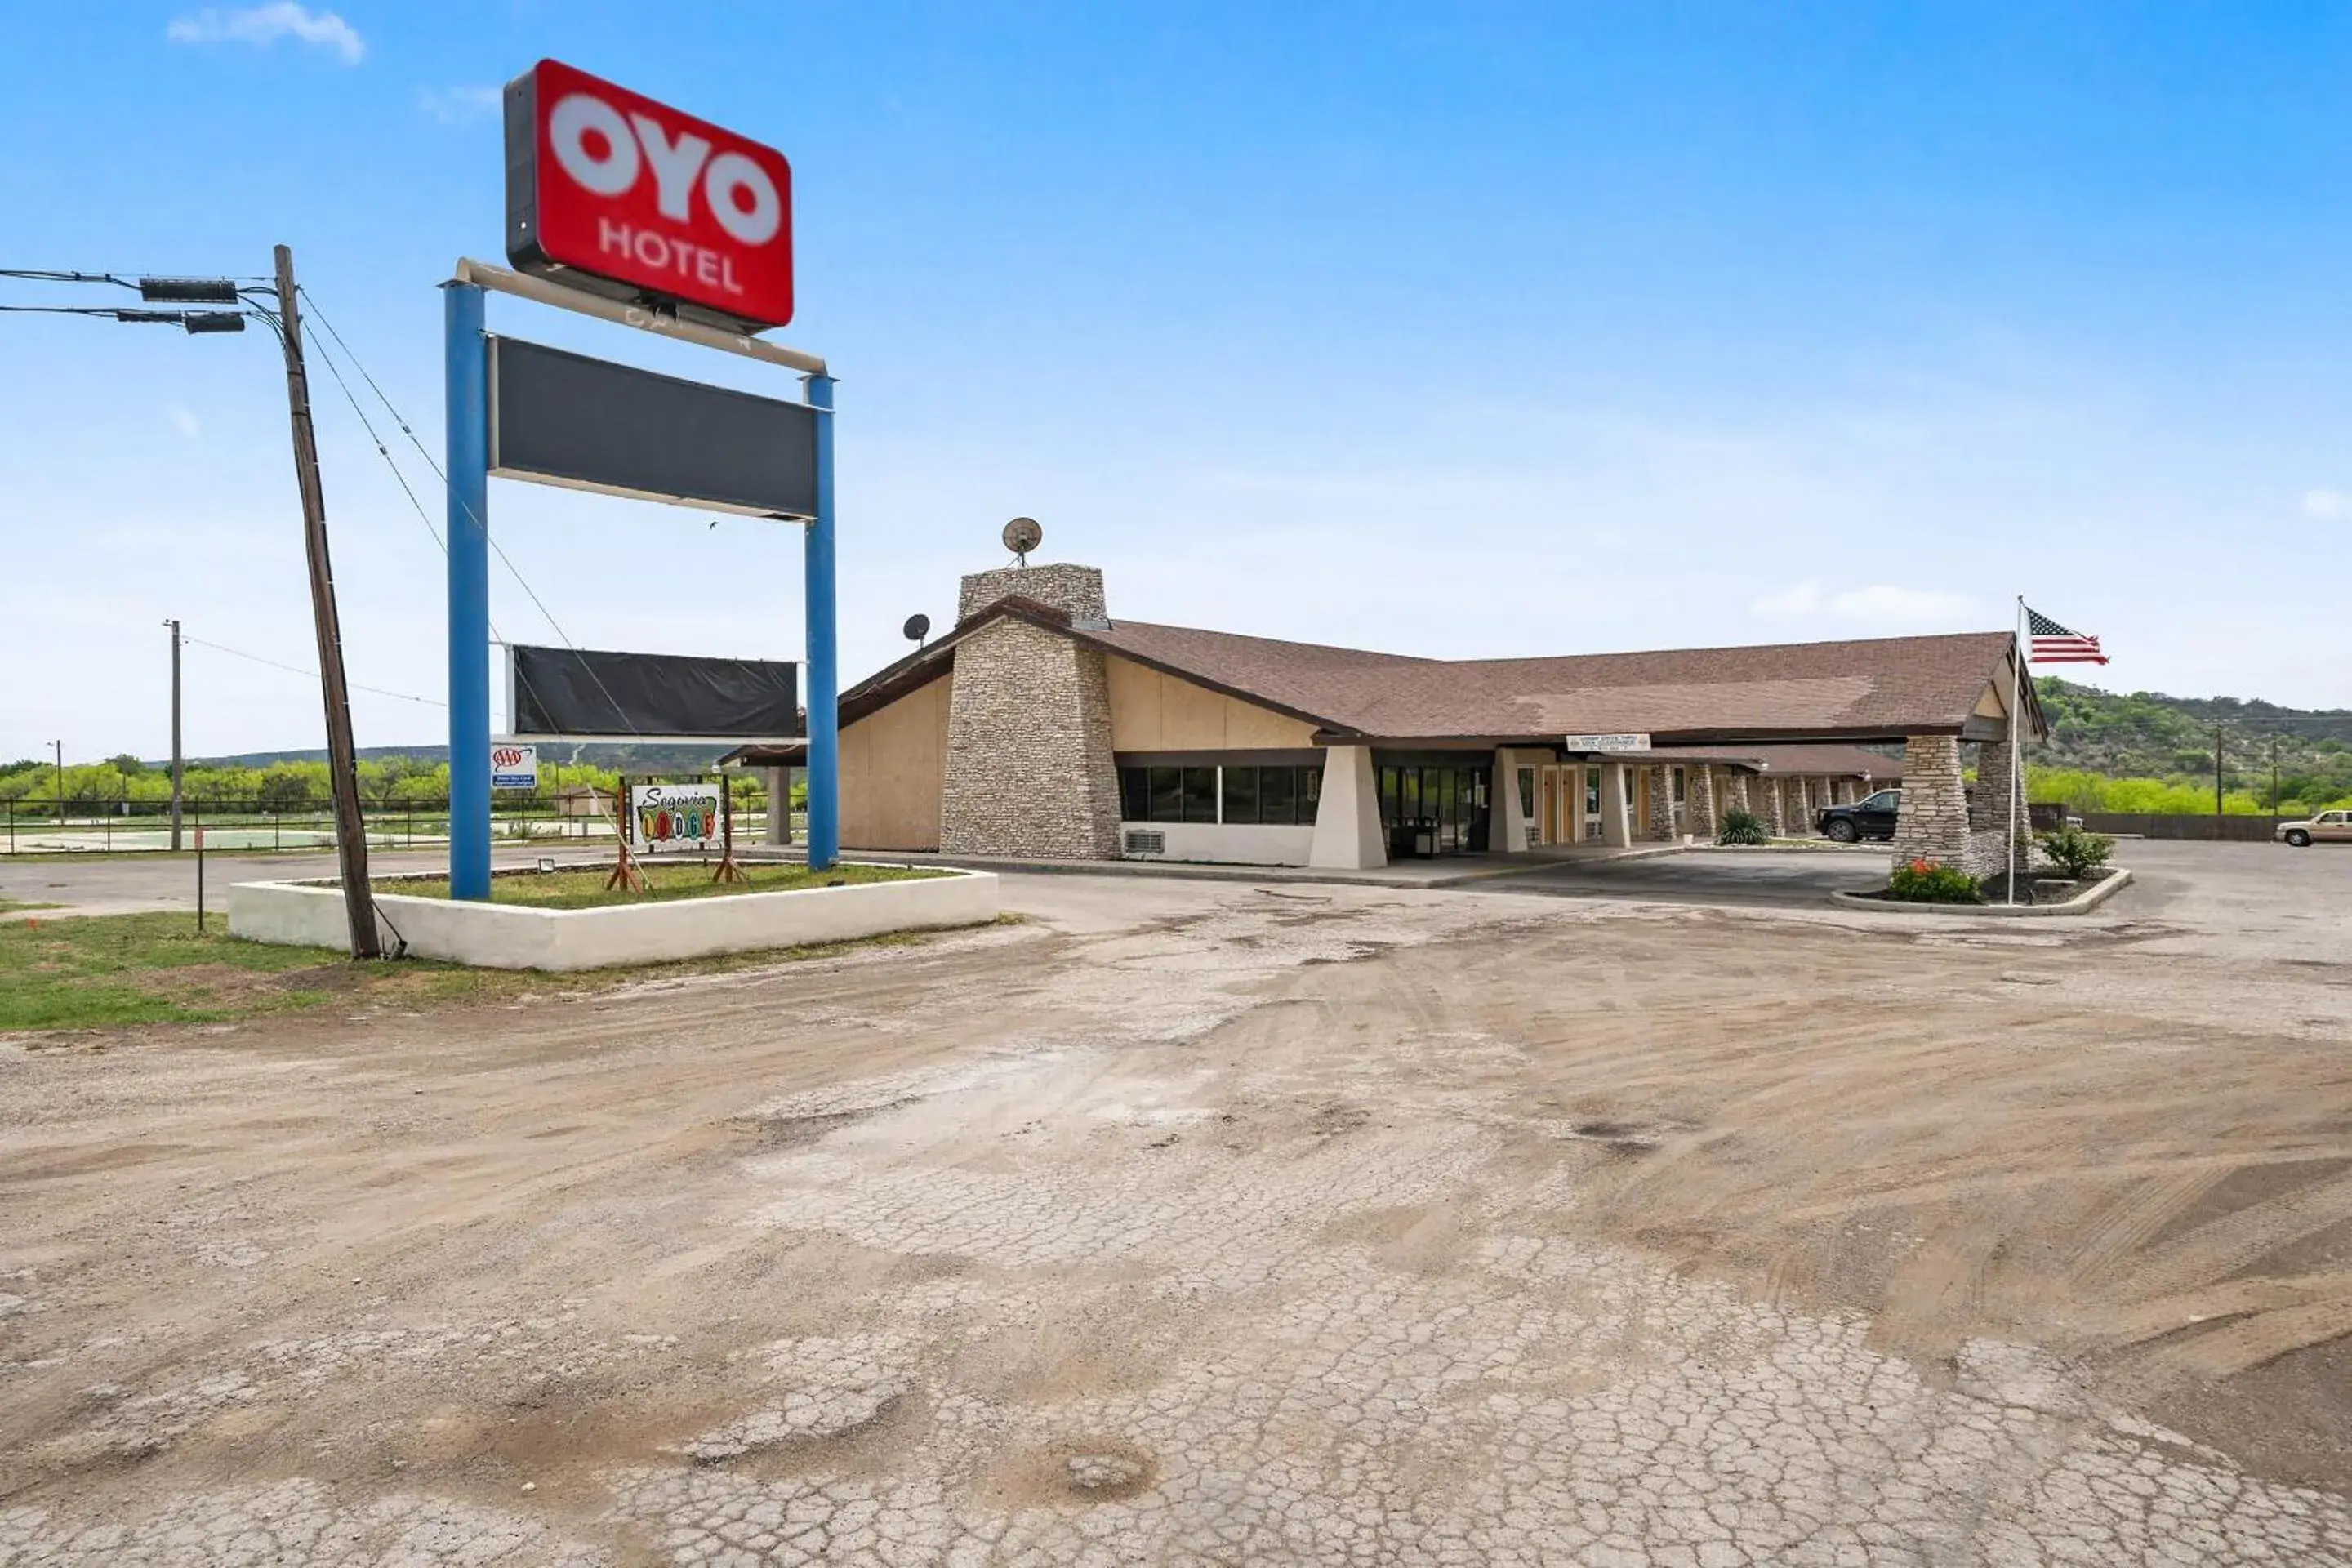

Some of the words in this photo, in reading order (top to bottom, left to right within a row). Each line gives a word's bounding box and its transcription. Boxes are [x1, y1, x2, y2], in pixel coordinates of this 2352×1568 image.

[549, 92, 782, 246] OYO
[598, 216, 743, 296] HOTEL
[642, 787, 706, 811] Segovia
[644, 813, 714, 838] LODGE
